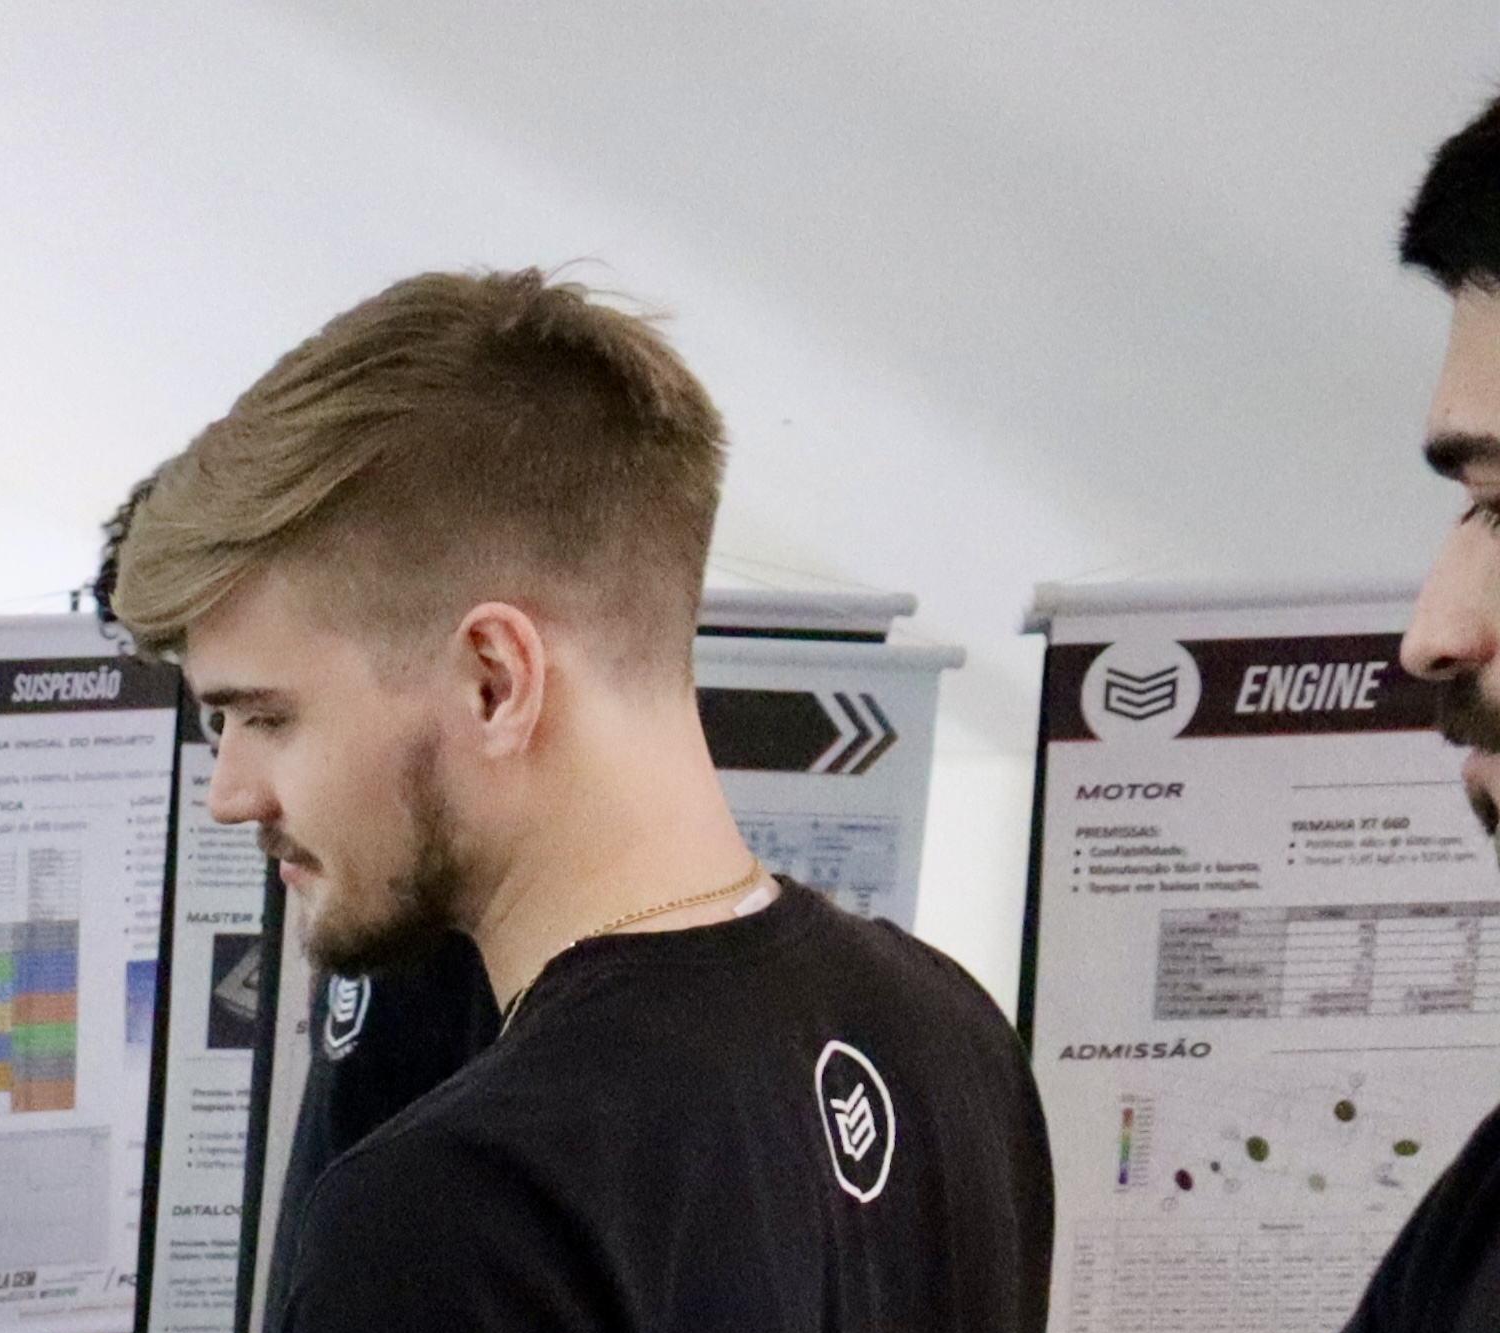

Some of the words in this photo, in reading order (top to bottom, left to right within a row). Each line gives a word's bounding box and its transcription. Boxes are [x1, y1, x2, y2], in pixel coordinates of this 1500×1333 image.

[11, 665, 122, 703] SUSPENSÃO
[1235, 660, 1388, 714] ENGINE
[1076, 782, 1185, 800] MOTOR
[187, 912, 253, 925] MASTER
[1059, 1040, 1212, 1061] ADMISSÃO
